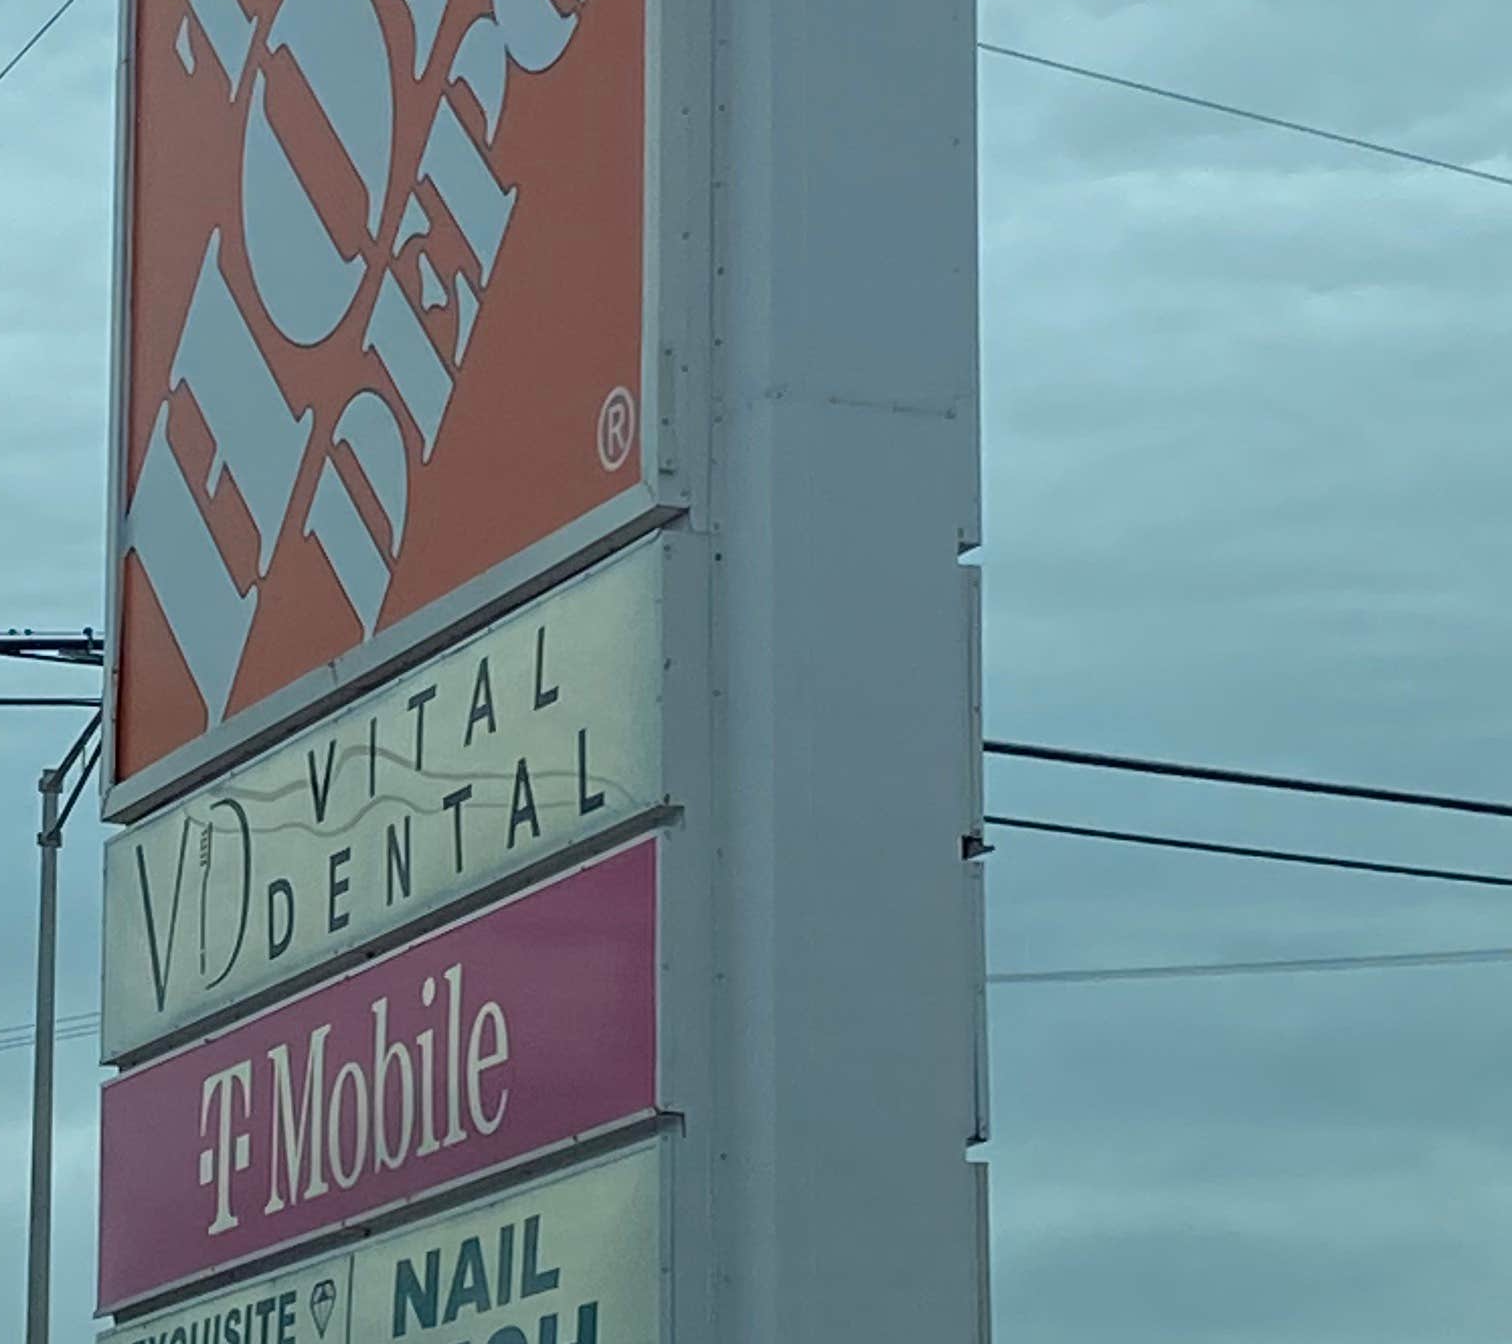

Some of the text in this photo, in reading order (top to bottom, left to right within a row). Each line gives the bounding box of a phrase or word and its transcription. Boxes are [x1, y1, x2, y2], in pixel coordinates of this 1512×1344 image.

[307, 625, 560, 824] VITAL
[268, 728, 606, 961] DENTAL
[392, 1214, 561, 1338] NAIL
